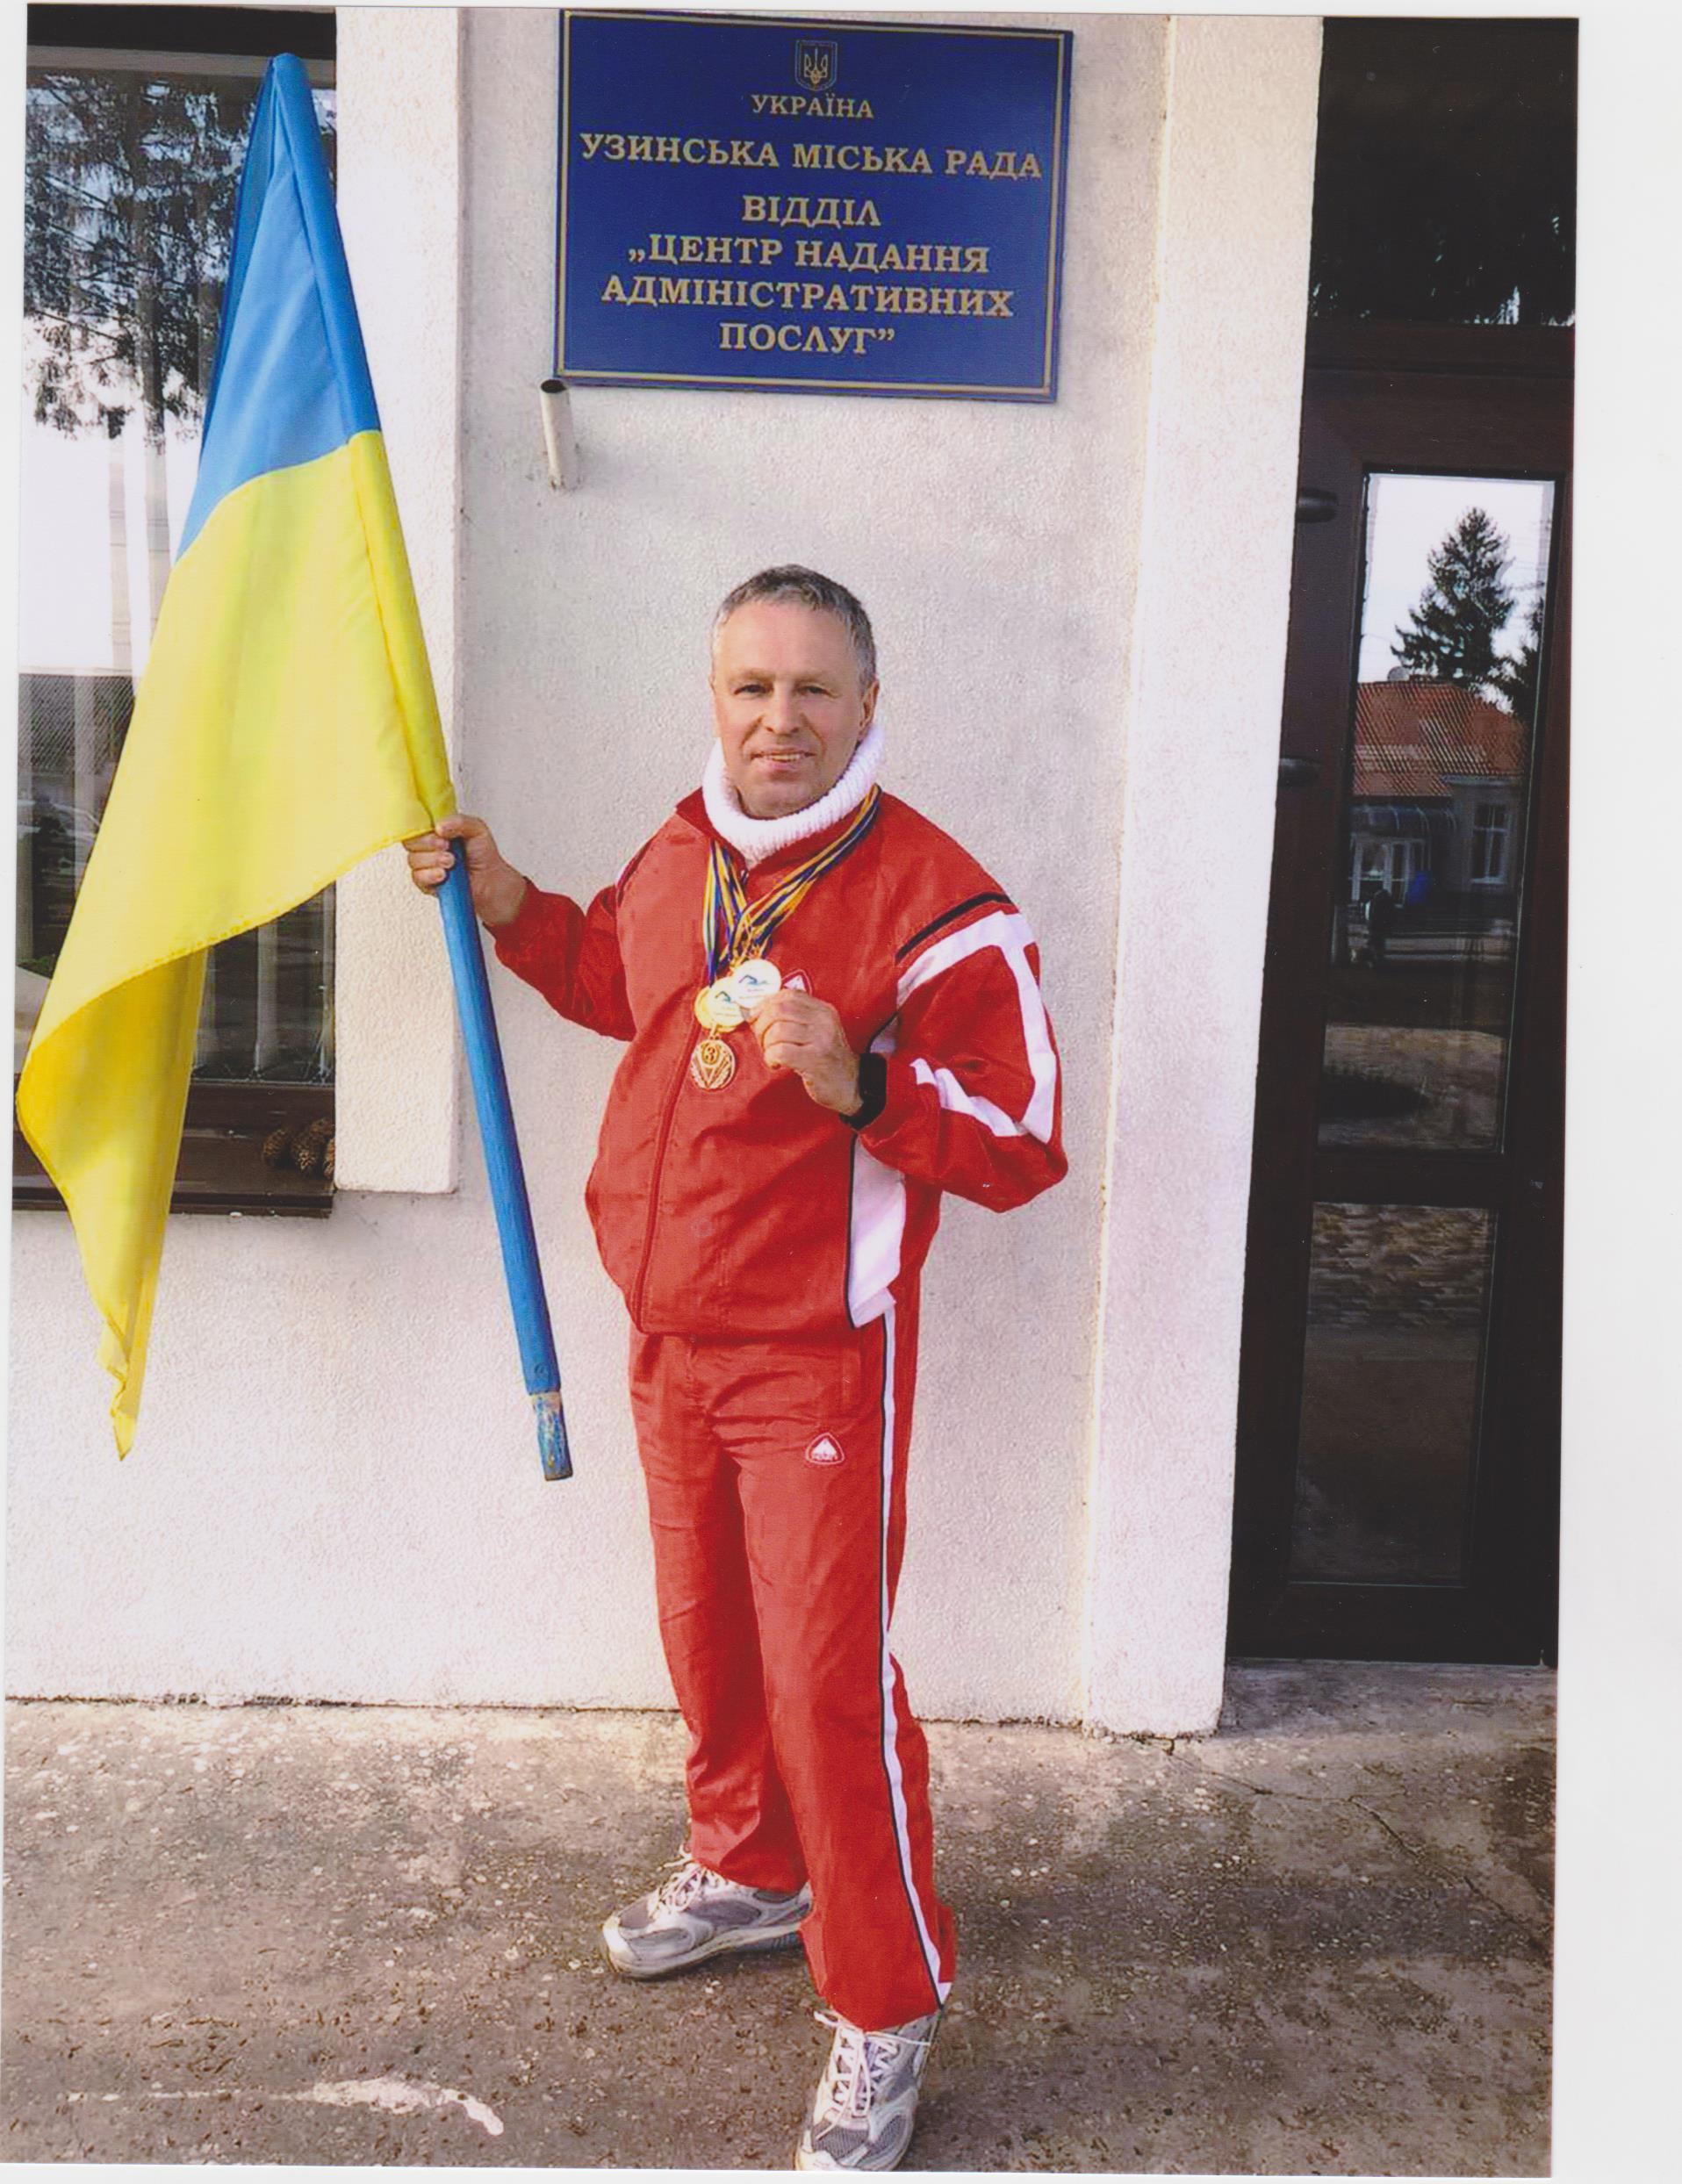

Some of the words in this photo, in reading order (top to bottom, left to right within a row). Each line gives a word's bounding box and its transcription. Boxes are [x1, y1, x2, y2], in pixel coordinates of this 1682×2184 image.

[752, 94, 873, 119] УКРАЇНА
[580, 133, 780, 167] УЗИНСЬКА
[793, 144, 933, 174] МІСЬКА
[945, 149, 1043, 181] РАДА
[742, 195, 881, 227] ВІДДІЛ
[795, 241, 989, 273] НАДАННЯ
[601, 275, 1014, 317] АДМІНІСТРАТИВНИХ
